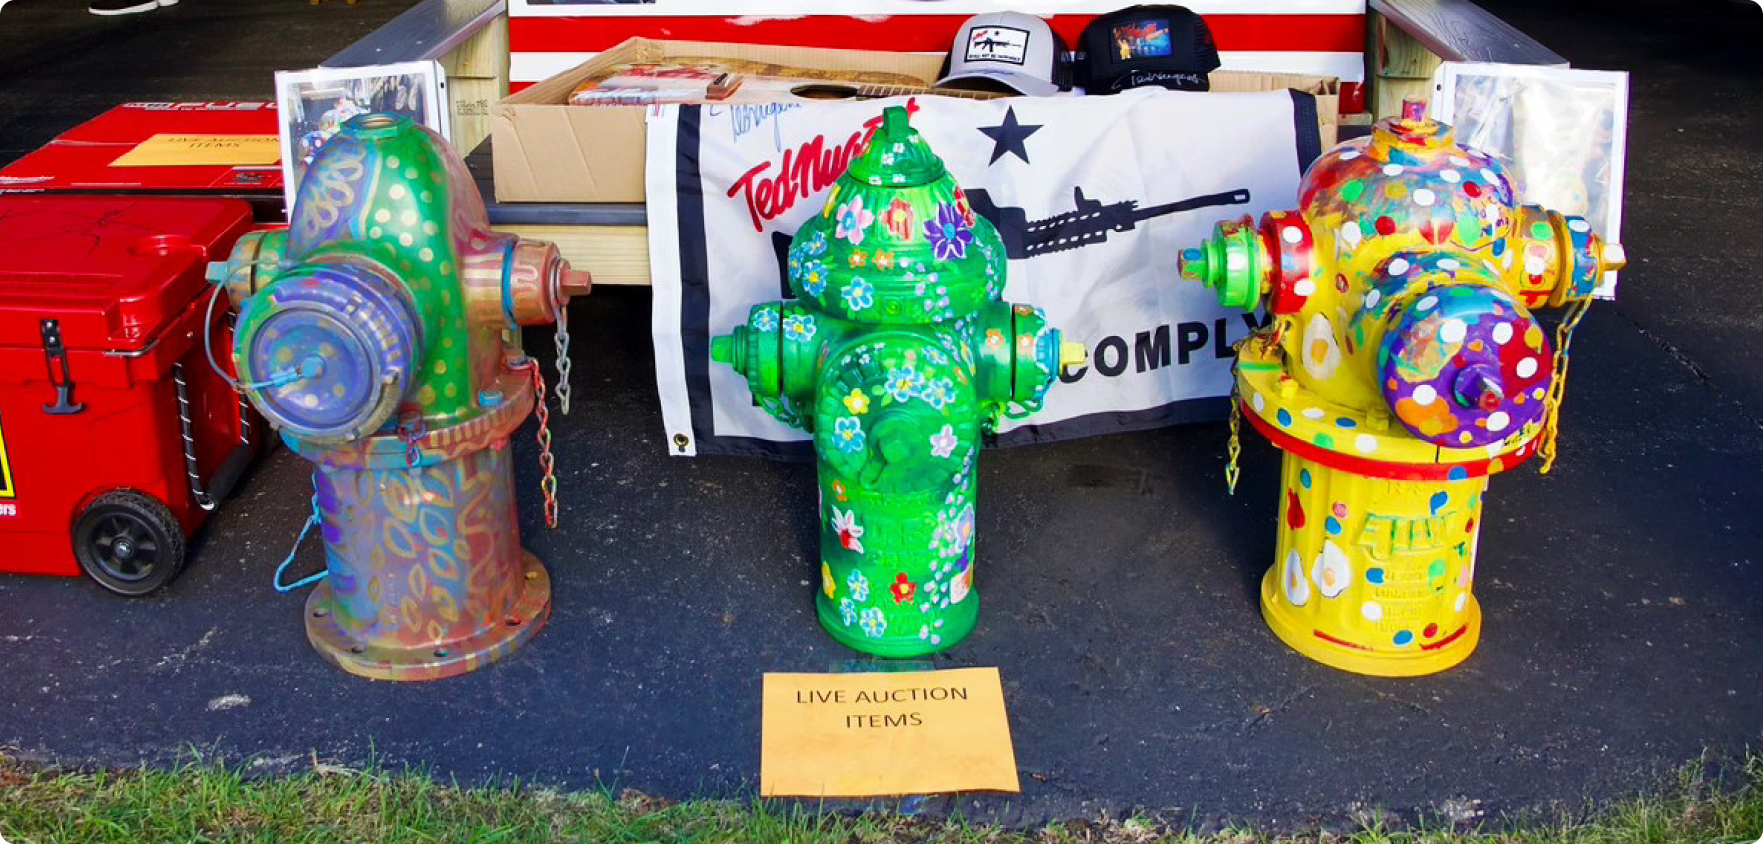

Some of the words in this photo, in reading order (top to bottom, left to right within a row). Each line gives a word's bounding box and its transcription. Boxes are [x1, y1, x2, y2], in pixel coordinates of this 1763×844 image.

[797, 690, 846, 704] LIVE
[855, 687, 968, 704] AUCTION
[846, 712, 923, 728] ITEMS
